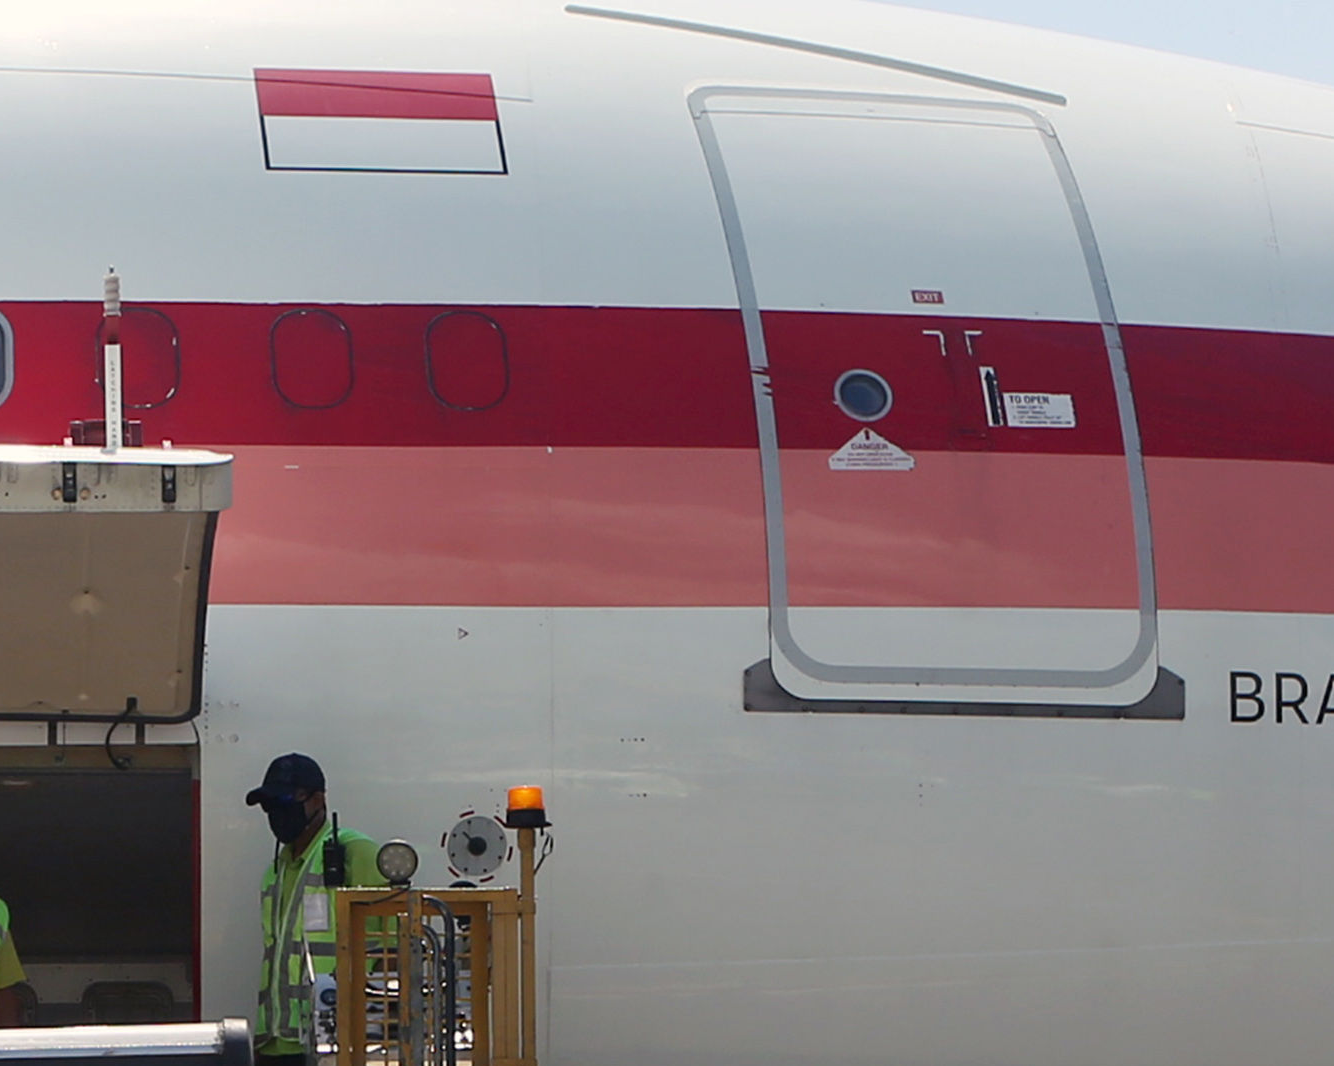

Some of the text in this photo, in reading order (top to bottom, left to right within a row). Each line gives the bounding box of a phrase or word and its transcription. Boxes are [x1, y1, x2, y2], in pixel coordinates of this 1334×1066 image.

[914, 292, 939, 302] EXIT
[1009, 395, 1050, 404] TO OPEN
[850, 443, 889, 451] DANGER
